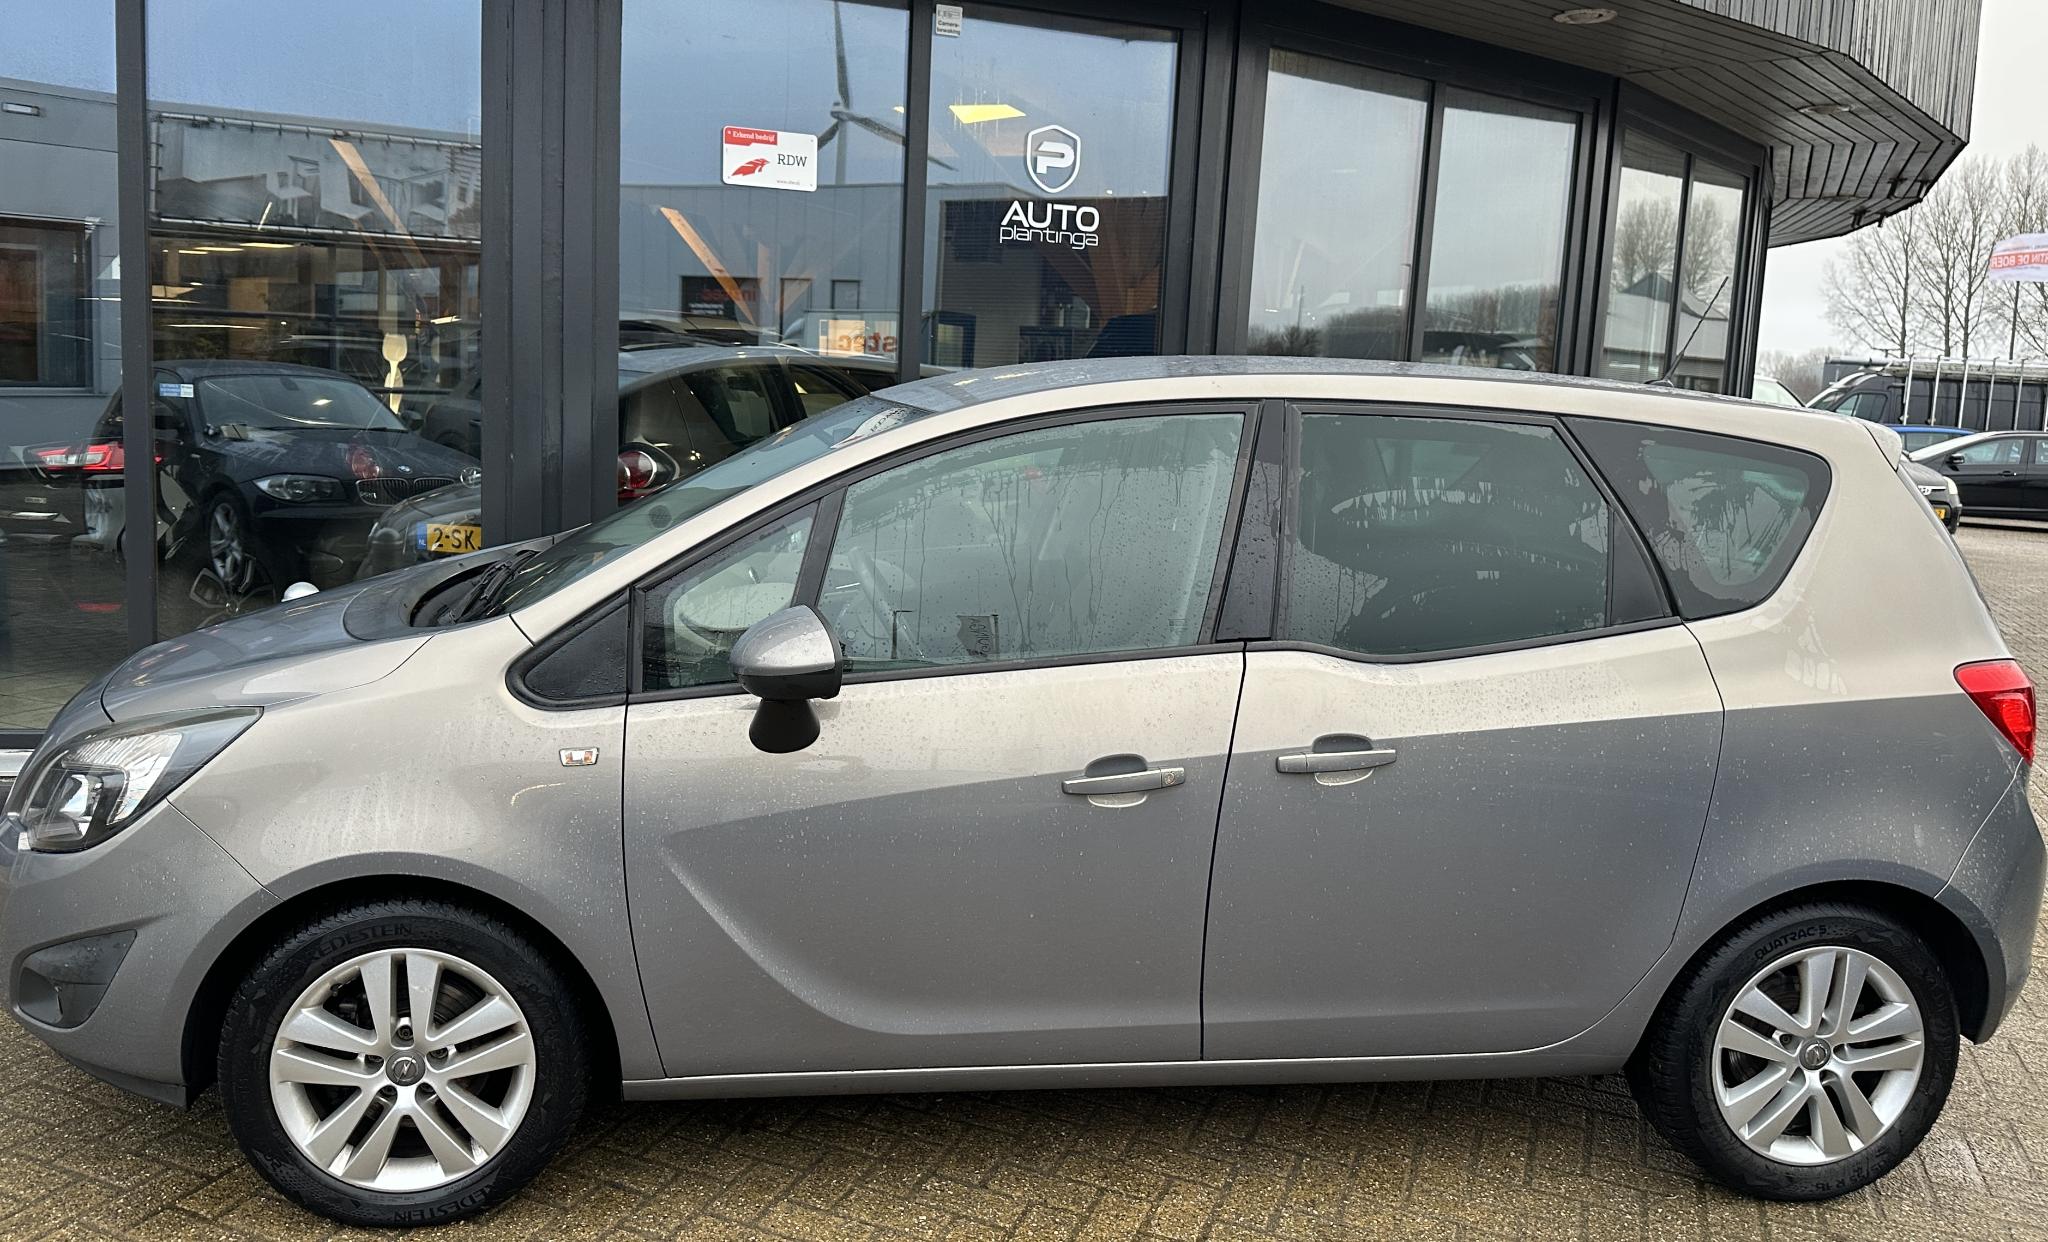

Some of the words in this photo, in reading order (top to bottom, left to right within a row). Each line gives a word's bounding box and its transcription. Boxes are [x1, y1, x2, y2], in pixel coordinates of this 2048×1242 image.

[732, 131, 755, 139] Erkend
[755, 133, 775, 142] bedrijf
[777, 154, 808, 168] RDW
[1001, 200, 1100, 232] AUTO
[999, 224, 1099, 250] plantinga
[433, 527, 481, 550] 2-SK
[1754, 926, 1816, 961] QUATRAC
